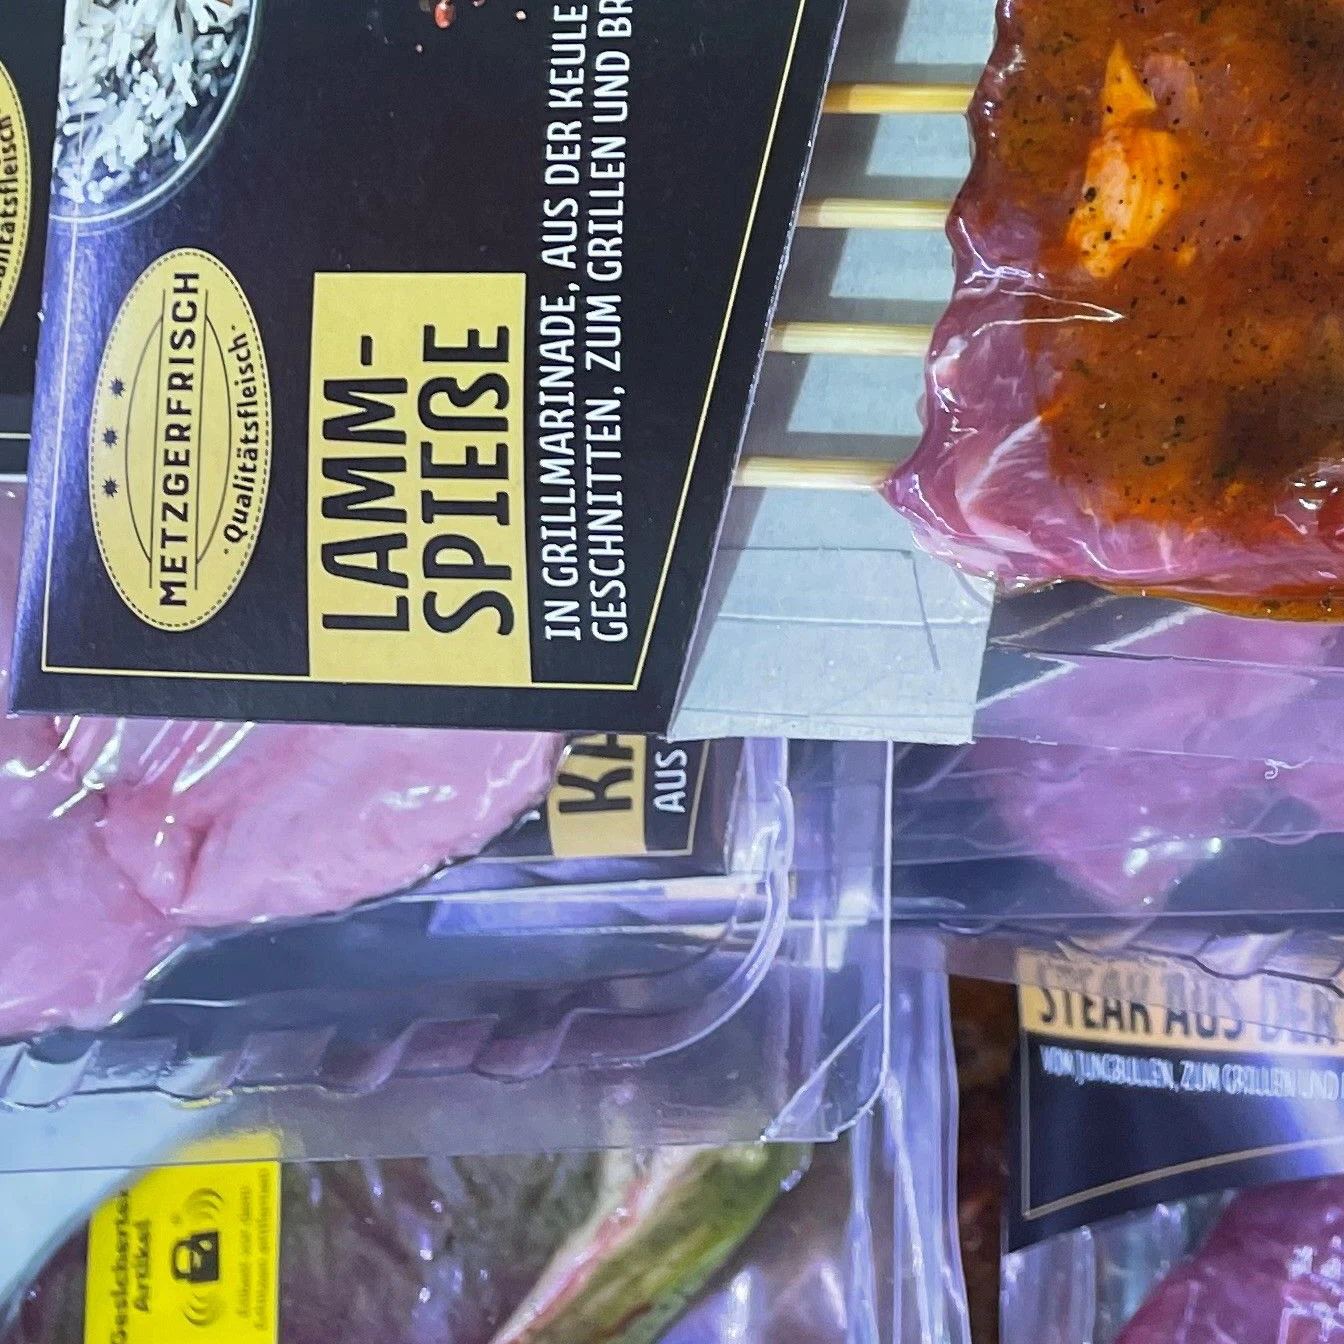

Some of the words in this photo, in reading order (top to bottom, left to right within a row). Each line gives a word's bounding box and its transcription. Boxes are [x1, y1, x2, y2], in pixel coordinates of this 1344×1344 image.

[548, 4, 588, 108] KEULE
[592, 50, 631, 123] UND
[544, 120, 582, 184] DER
[542, 198, 579, 270] AUS
[586, 136, 626, 282] GRILLEN
[585, 294, 623, 372] ZUM
[159, 272, 200, 607] METZGERFRISCH
[224, 332, 259, 545] Qualitätsfleisch
[320, 335, 410, 634] LAMM-
[539, 282, 580, 587] GRILLMARINADE,
[585, 385, 630, 643] GESCHNITTEN,
[544, 600, 581, 642] IN
[653, 749, 688, 813] AUS
